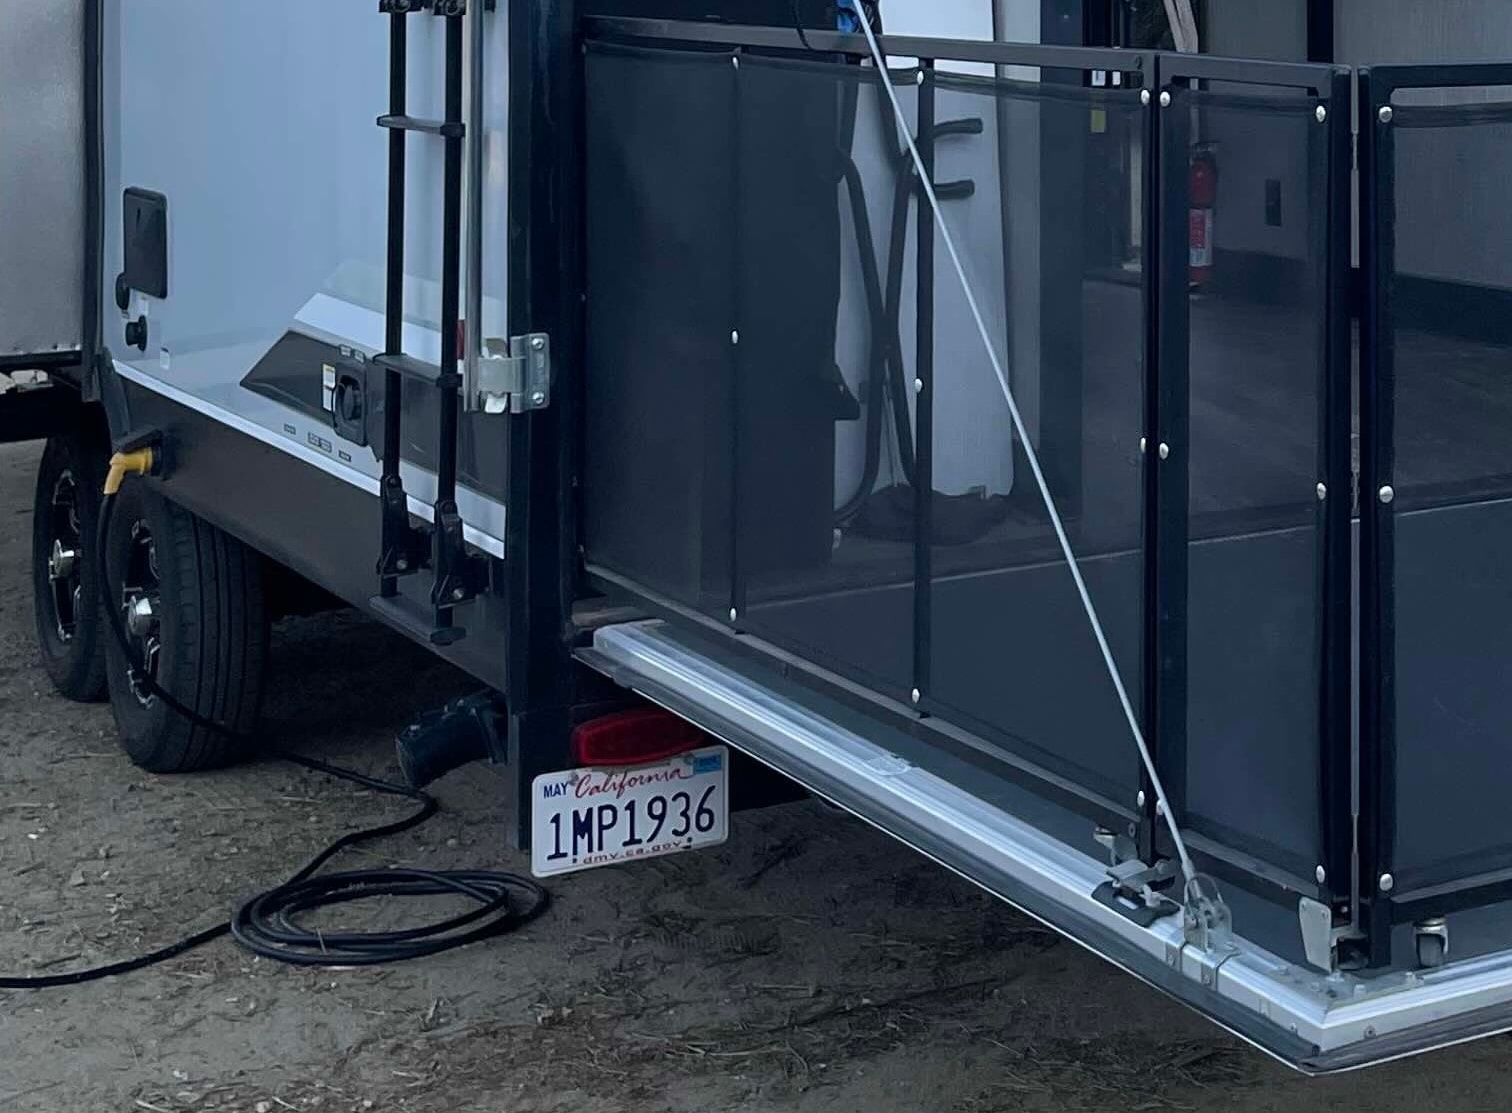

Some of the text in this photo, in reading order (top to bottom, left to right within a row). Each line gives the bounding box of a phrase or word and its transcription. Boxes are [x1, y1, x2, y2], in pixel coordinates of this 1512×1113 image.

[543, 766, 694, 799] MAY California
[547, 785, 716, 861] 1MP1936
[583, 839, 682, 865] dmv.ca.gov
